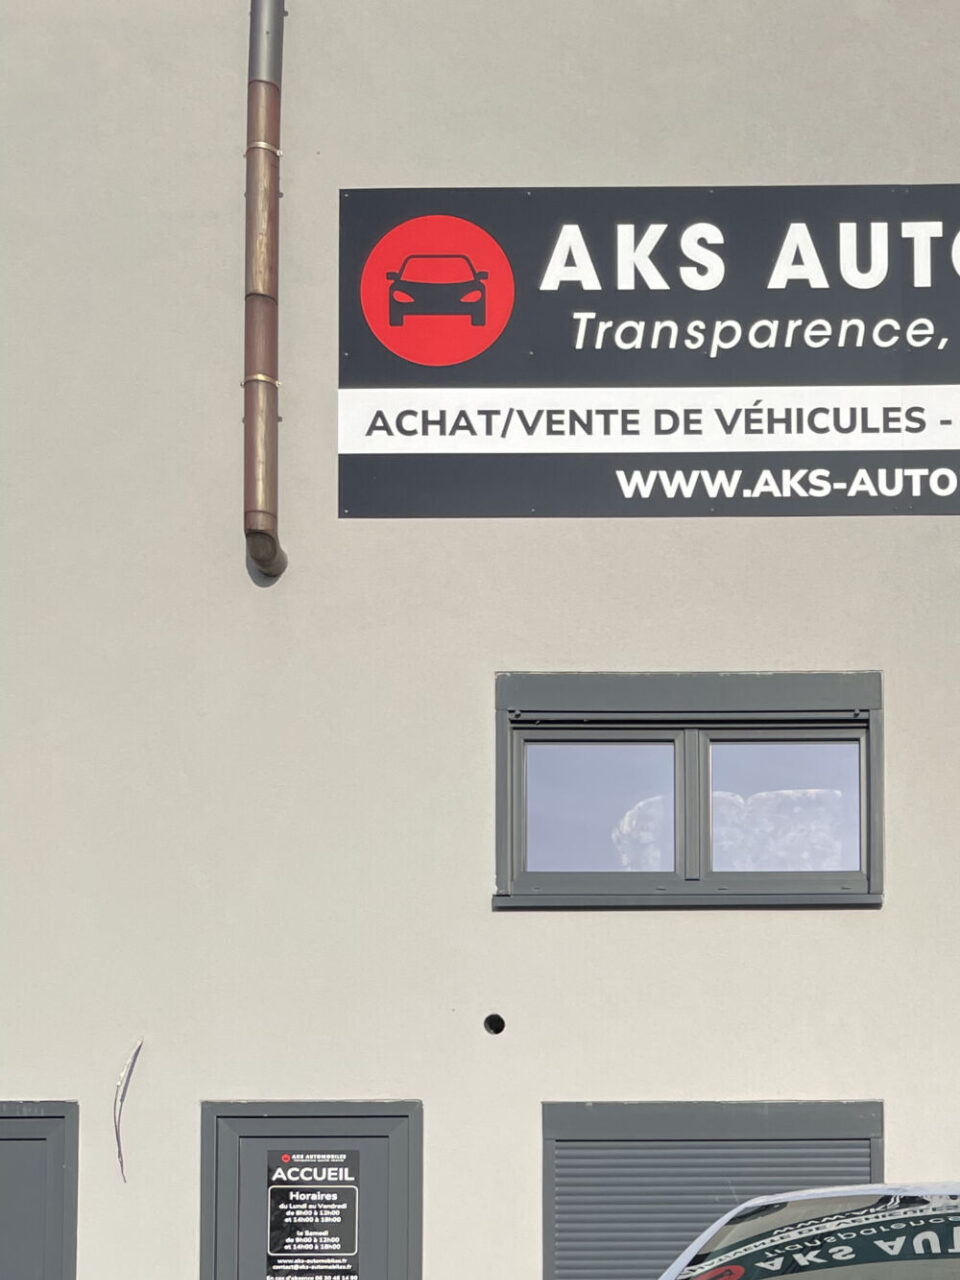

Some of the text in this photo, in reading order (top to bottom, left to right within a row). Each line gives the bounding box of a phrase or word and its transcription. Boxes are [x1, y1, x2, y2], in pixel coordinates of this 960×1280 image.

[538, 221, 726, 292] AKS
[571, 310, 950, 358] Transparence,
[365, 408, 641, 439] ACHAT/VENTE
[653, 409, 704, 437] DE
[713, 399, 928, 436] VÉHICULES
[272, 1166, 355, 1182] ACCUEIL
[289, 1191, 338, 1201] Horaires
